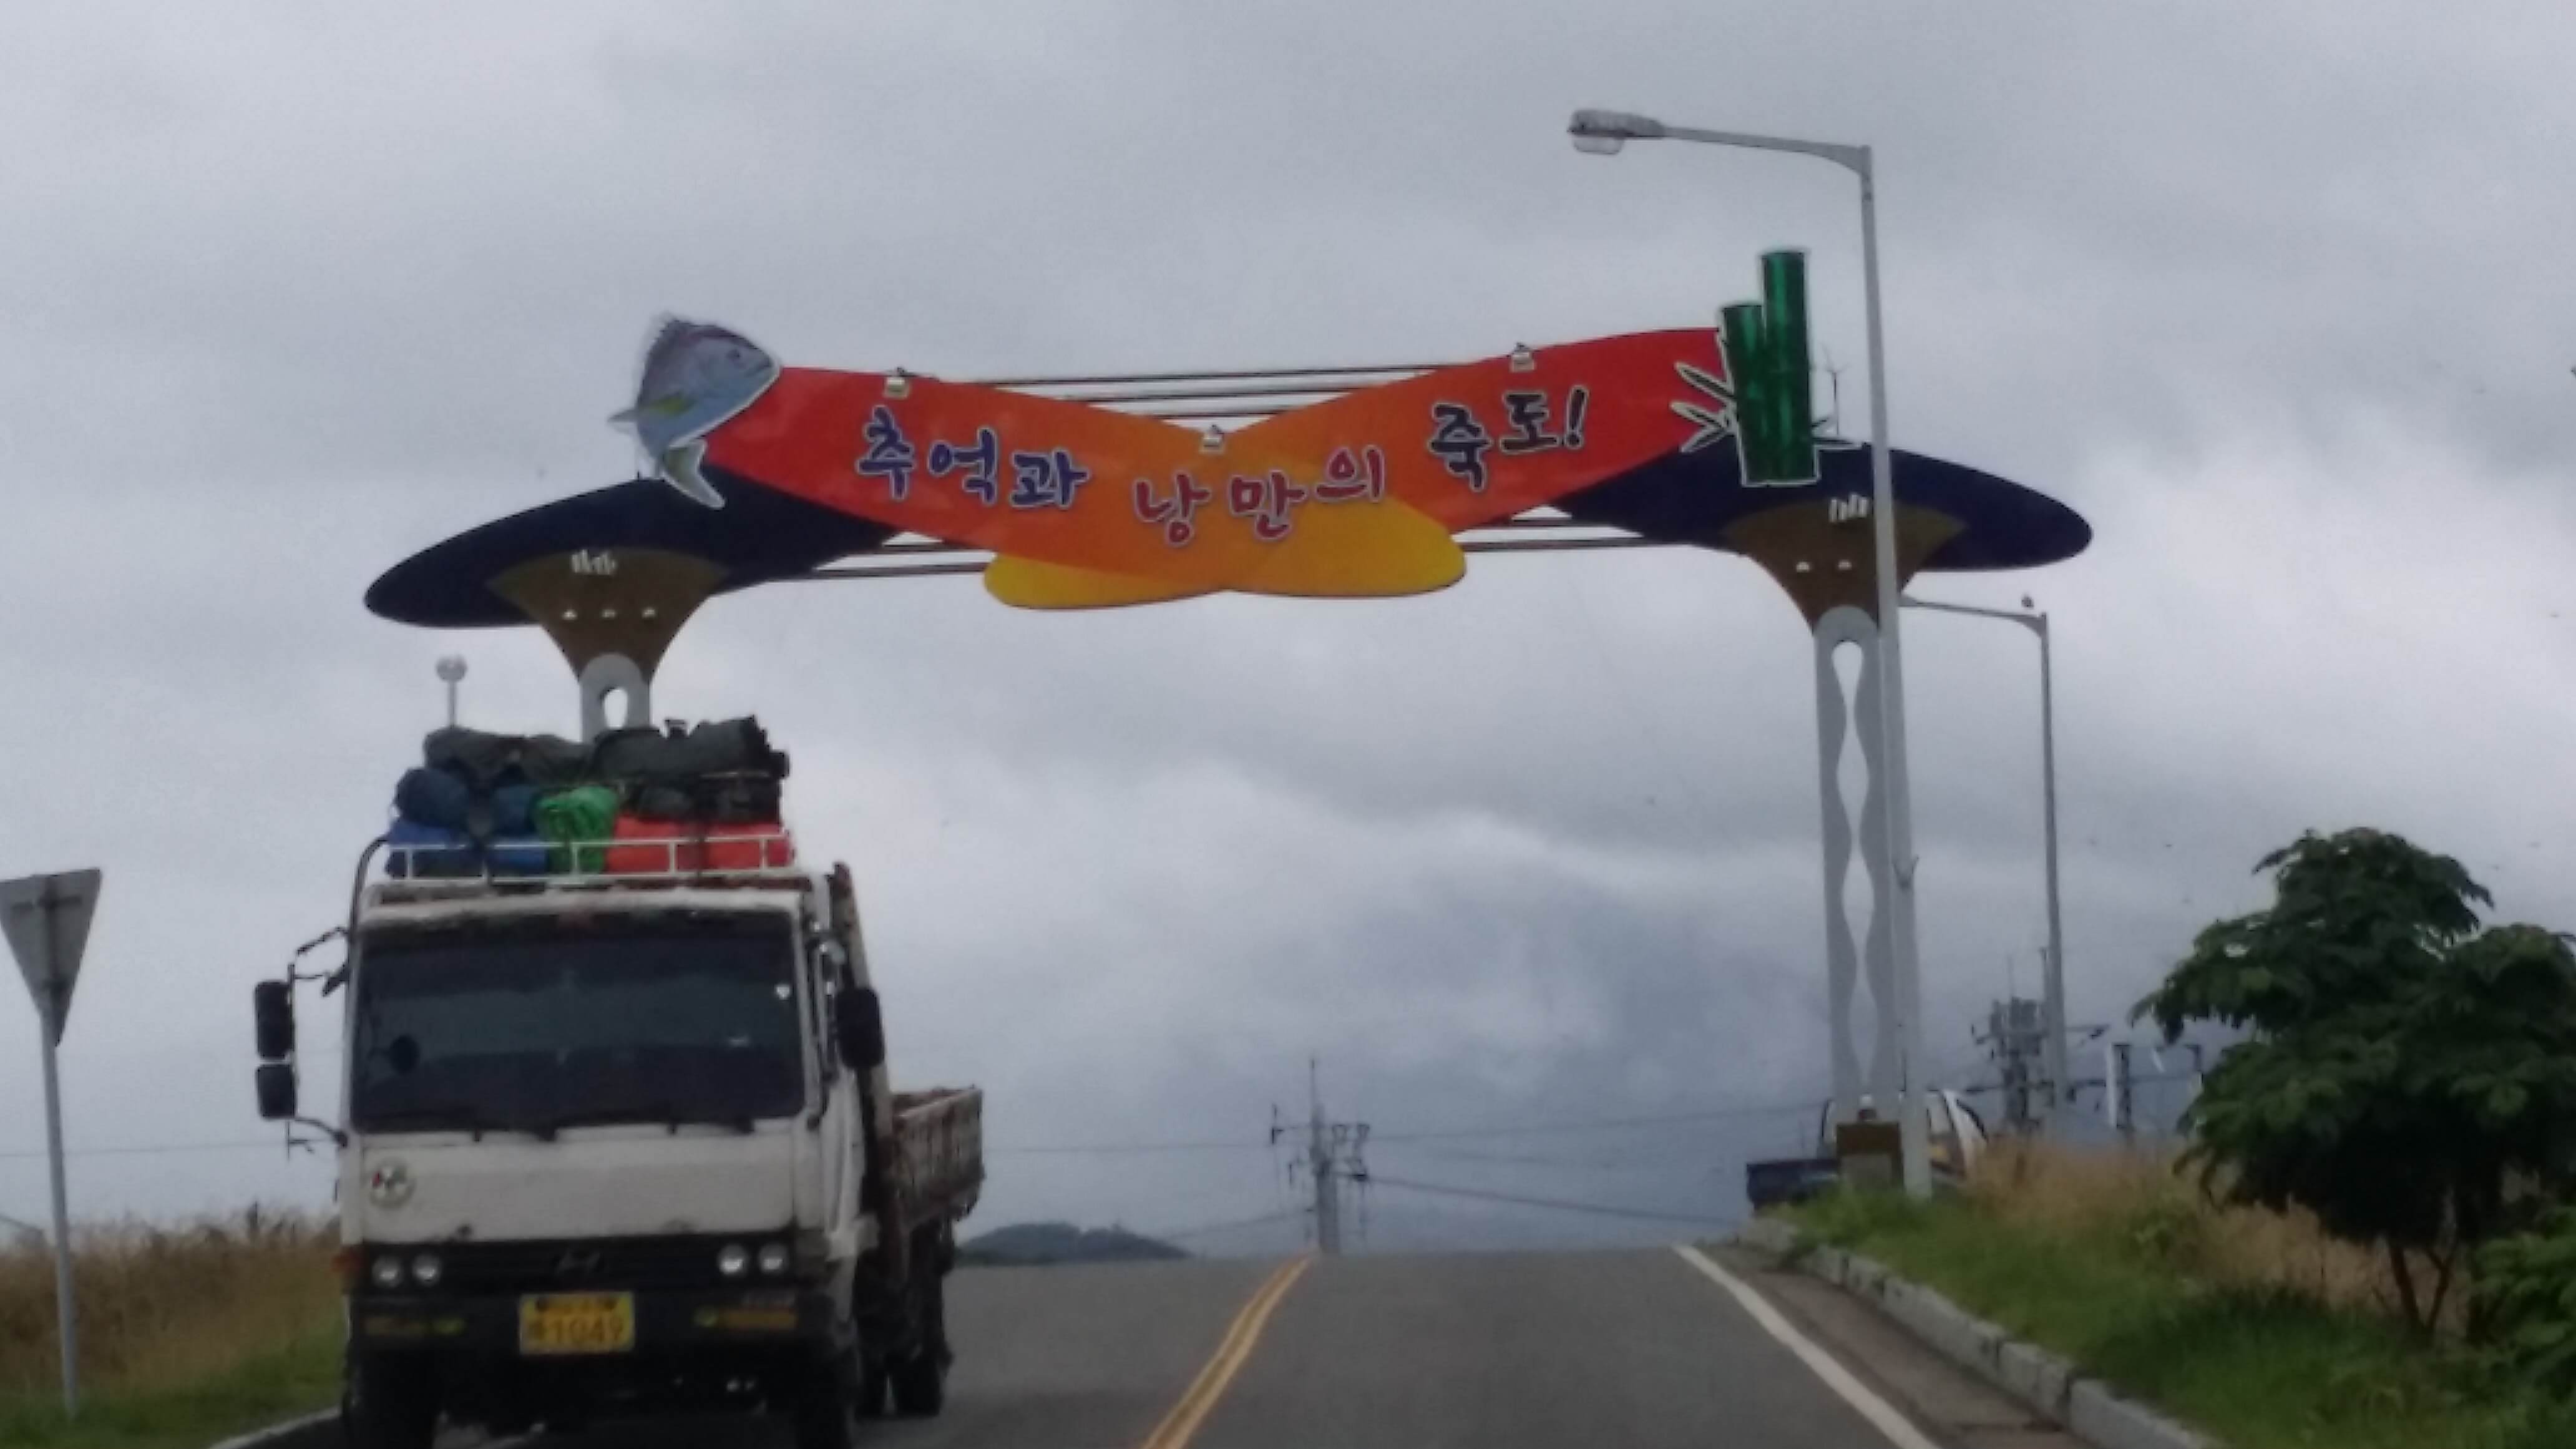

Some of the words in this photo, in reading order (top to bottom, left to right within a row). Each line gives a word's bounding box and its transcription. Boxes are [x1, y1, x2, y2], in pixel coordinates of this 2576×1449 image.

[856, 404, 1090, 509] 추억과
[1134, 447, 1385, 546] 낭만의
[1428, 386, 1589, 490] 죽도!
